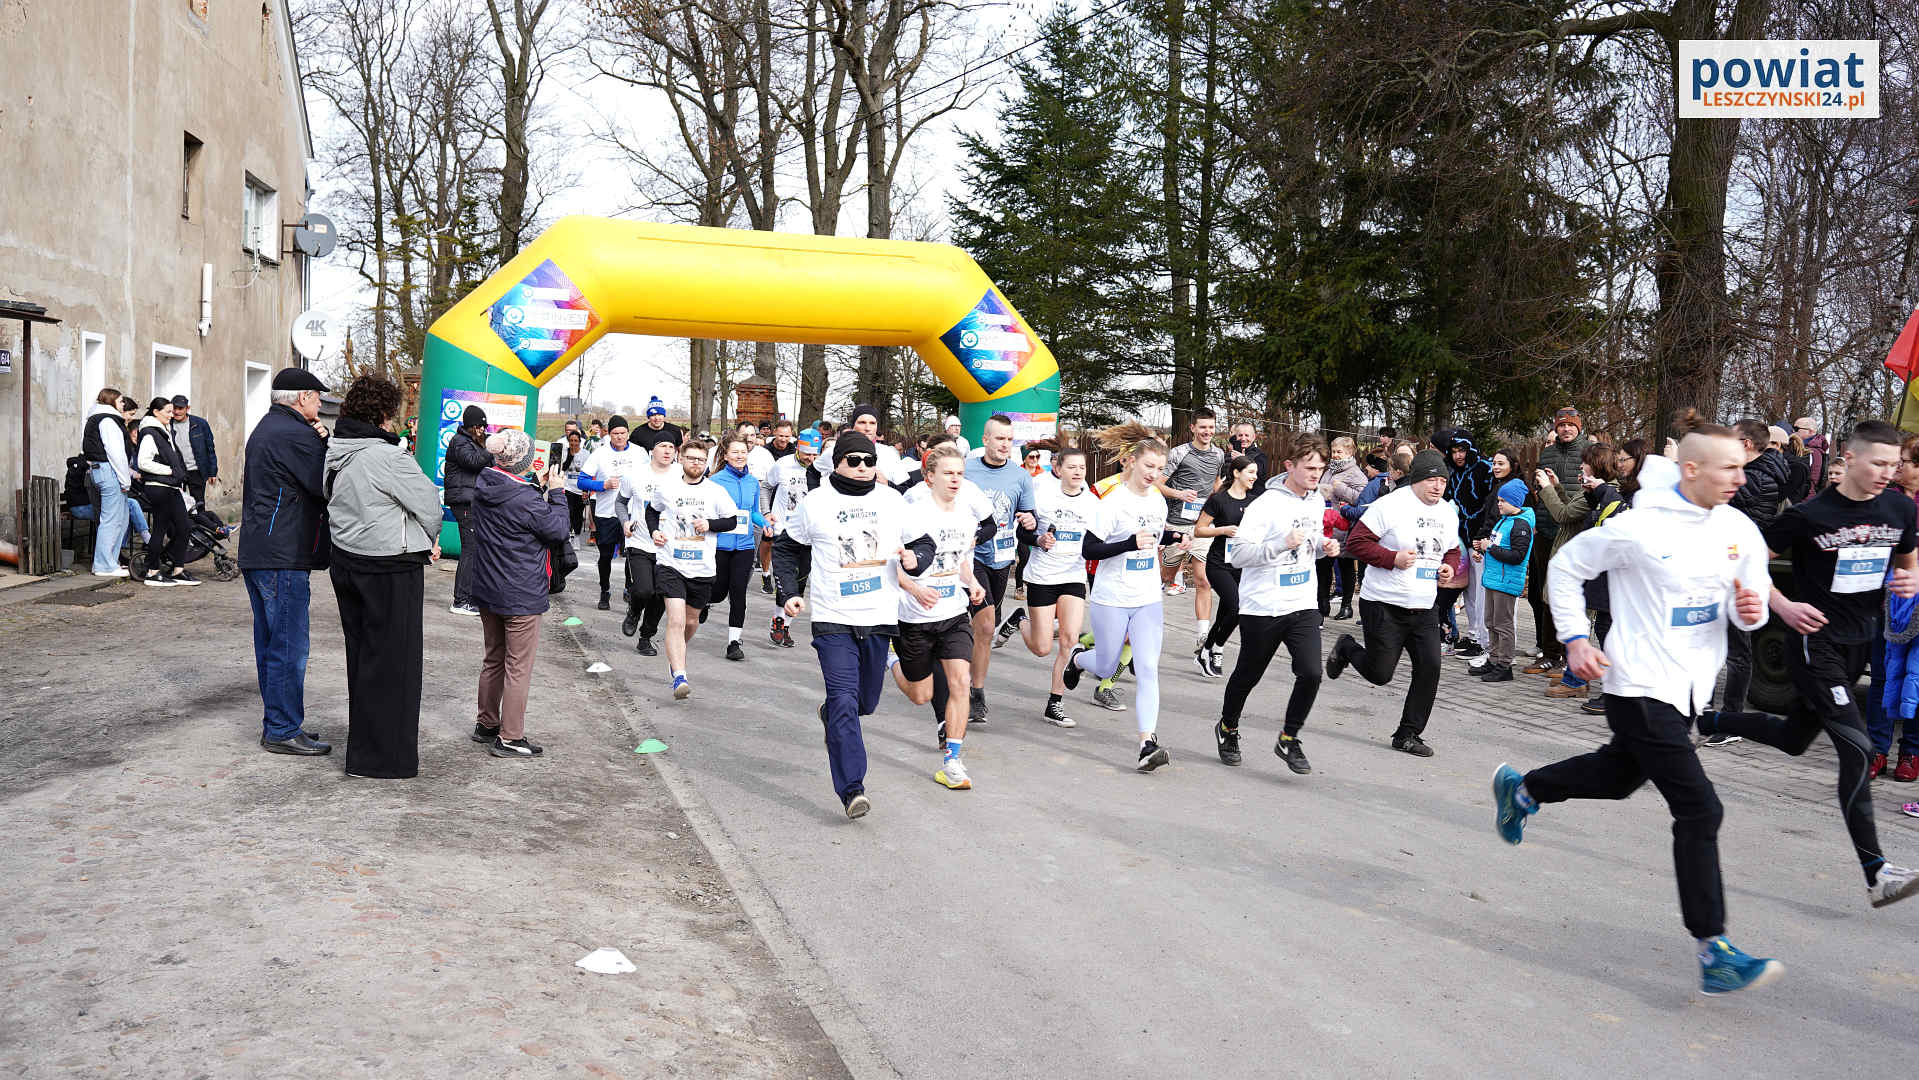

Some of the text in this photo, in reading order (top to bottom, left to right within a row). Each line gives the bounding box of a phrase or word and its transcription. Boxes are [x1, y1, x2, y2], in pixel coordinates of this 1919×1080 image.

[305, 320, 327, 331] 4K
[681, 551, 695, 559] 054
[1136, 560, 1149, 569] 091
[1290, 574, 1305, 584] 031
[852, 580, 871, 593] 058
